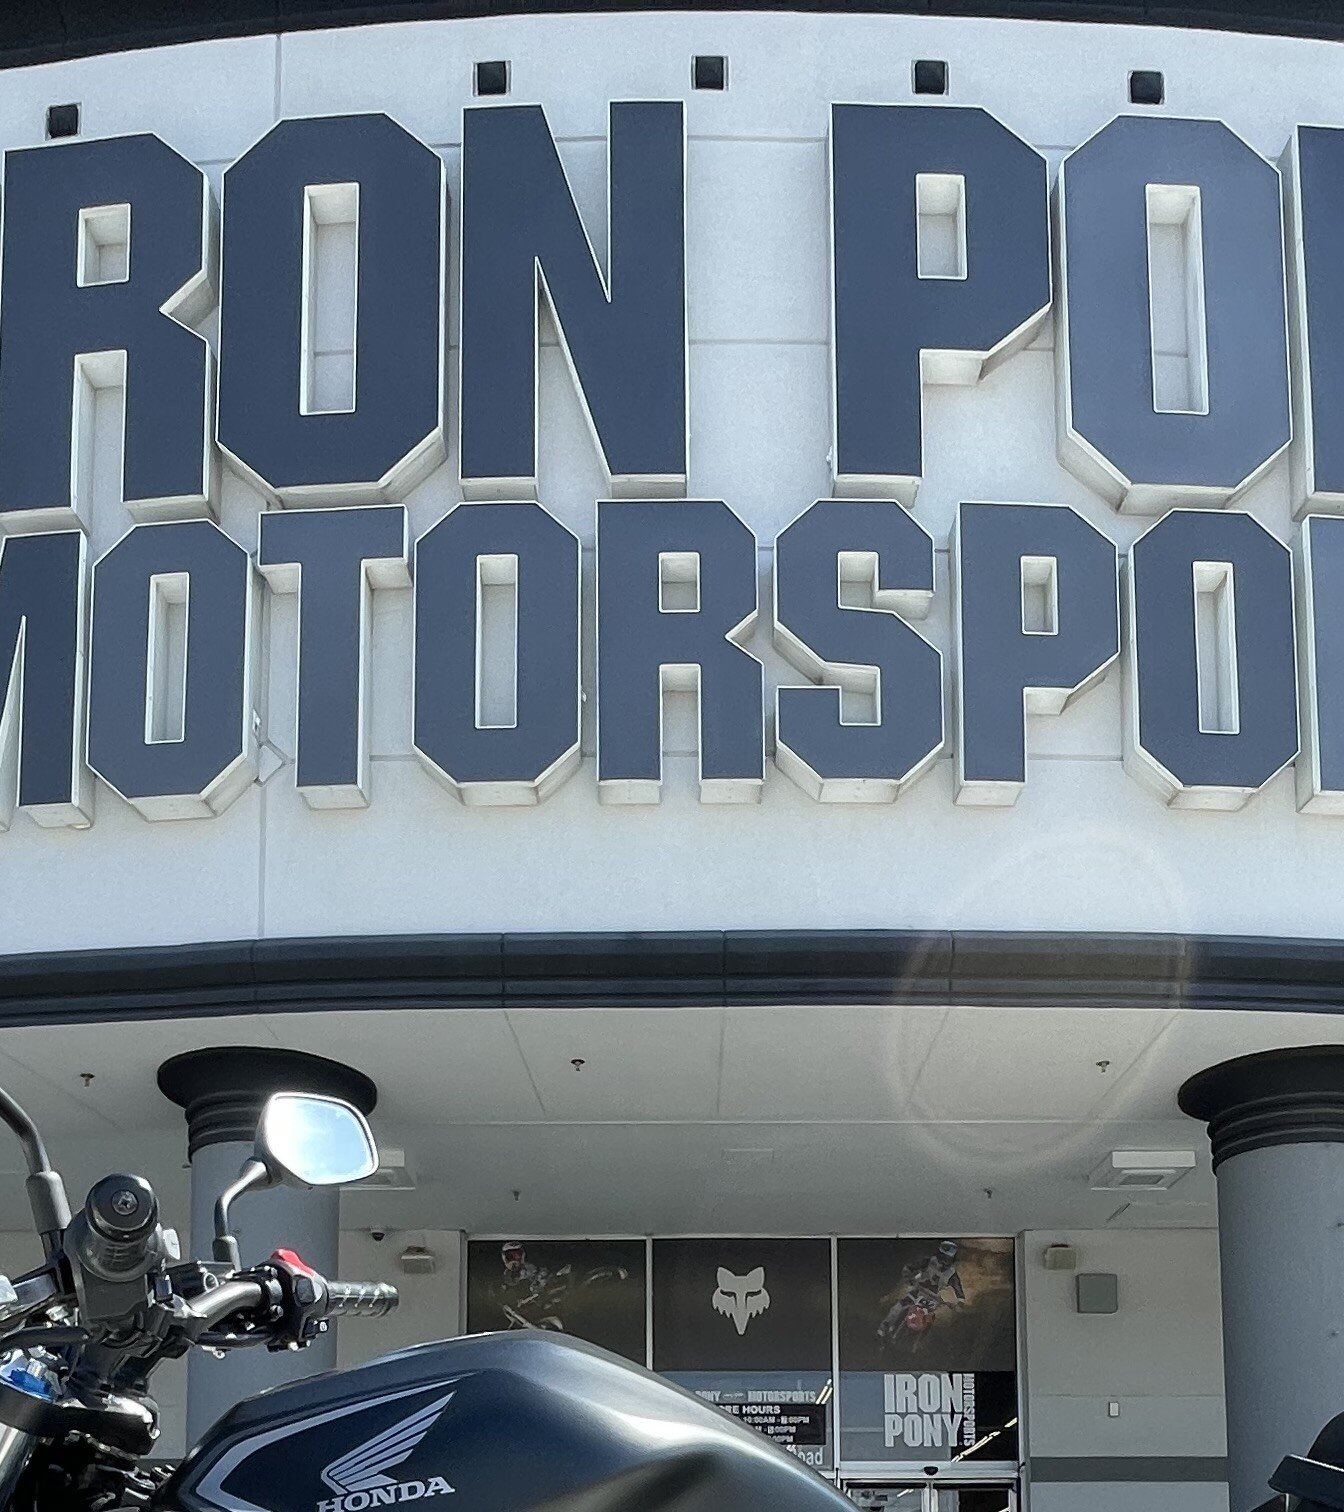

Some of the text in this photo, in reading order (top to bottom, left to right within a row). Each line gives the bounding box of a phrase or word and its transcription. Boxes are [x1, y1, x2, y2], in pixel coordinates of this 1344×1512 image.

[742, 1405, 781, 1414] HOURS
[884, 1373, 963, 1413] IRON
[884, 1413, 963, 1447] PONY
